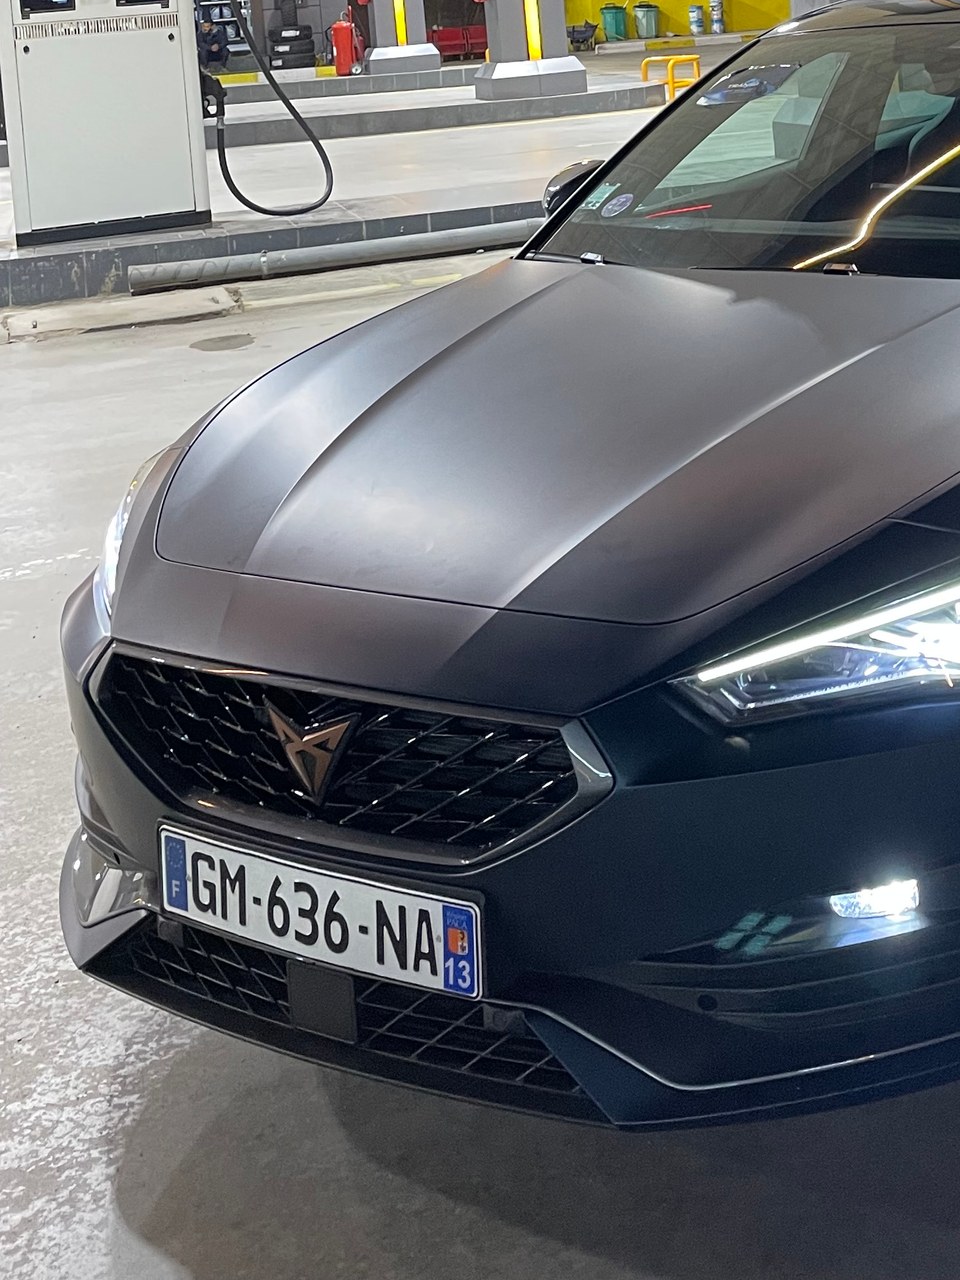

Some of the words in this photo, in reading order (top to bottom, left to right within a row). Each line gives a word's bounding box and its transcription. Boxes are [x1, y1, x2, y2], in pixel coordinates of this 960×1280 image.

[171, 879, 181, 899] F
[191, 851, 438, 977] GM-636-NA
[445, 957, 471, 989] 13
